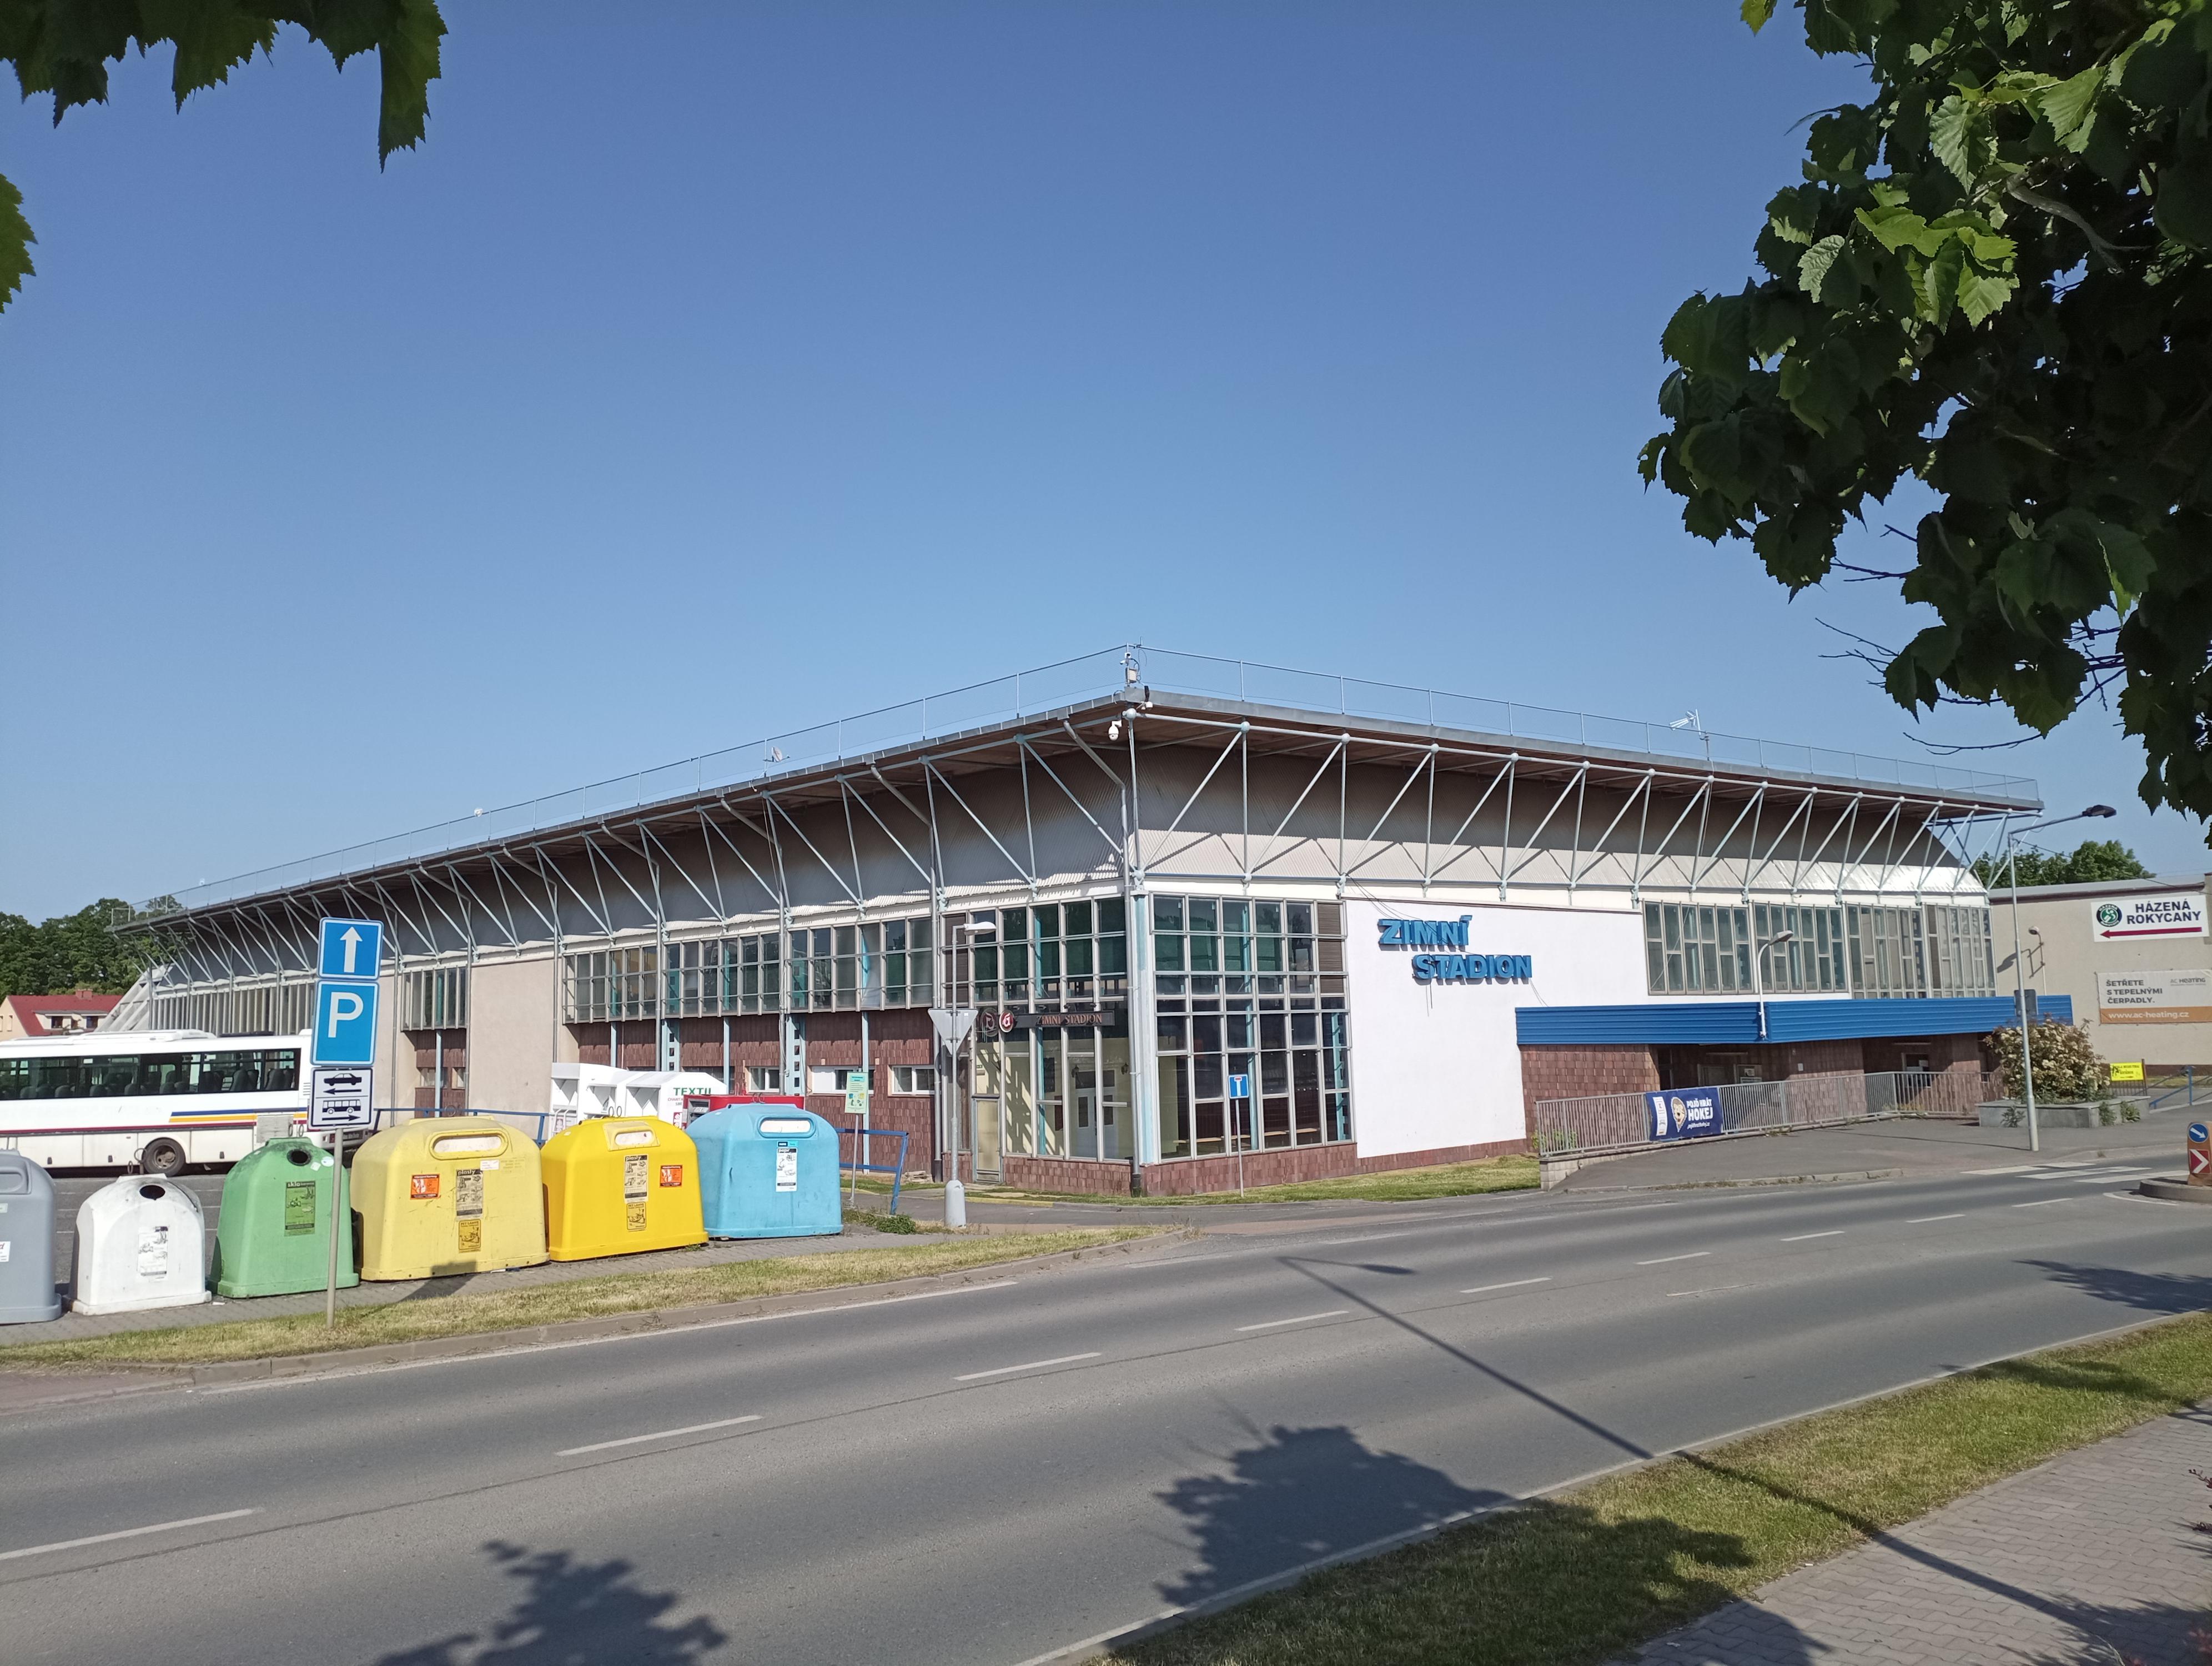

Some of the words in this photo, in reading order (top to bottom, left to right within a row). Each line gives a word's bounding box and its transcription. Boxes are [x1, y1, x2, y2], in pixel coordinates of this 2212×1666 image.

[2135, 899, 2191, 913] HÁZENÁ
[2126, 911, 2201, 925] ROKYCANY
[1378, 915, 1472, 945] ZIMNÍ
[1412, 954, 1532, 979] STADION
[328, 991, 364, 1038] P
[1065, 1013, 1102, 1025] STADION
[2108, 1011, 2189, 1019] www.ac-heating.cz
[1688, 1107, 1713, 1121] HOKEJ
